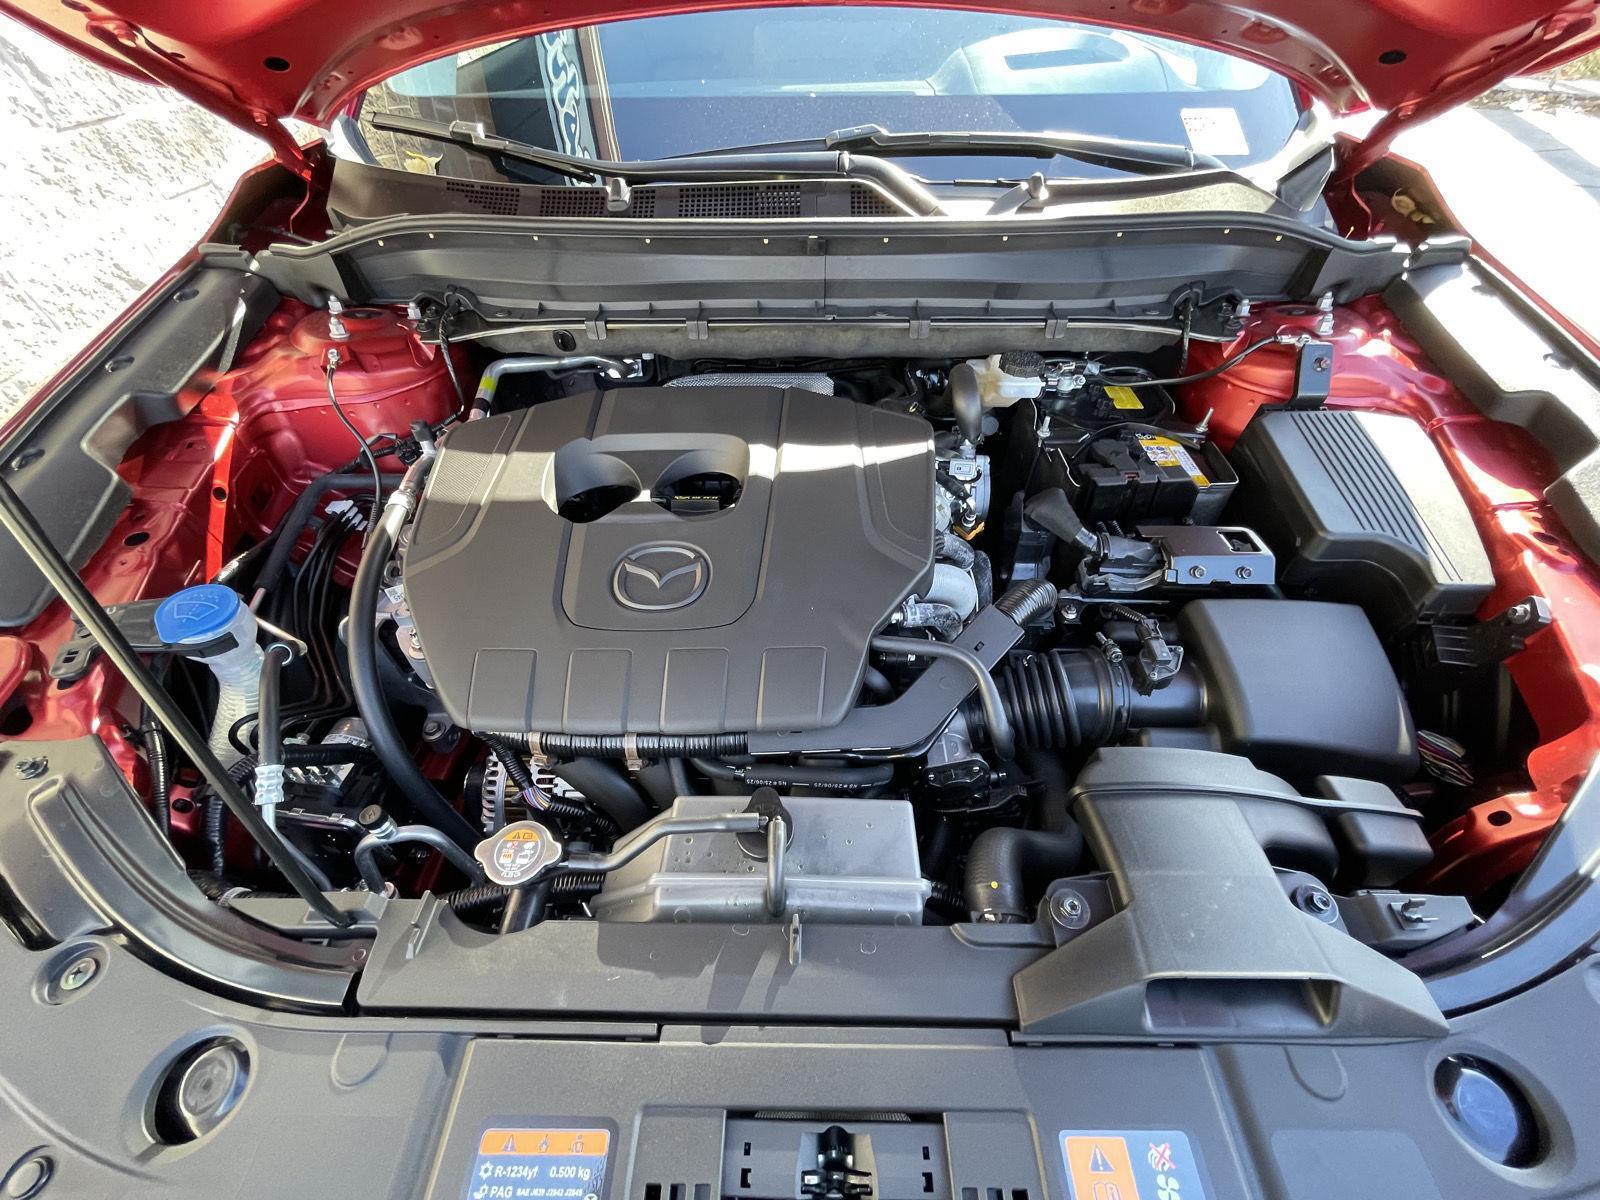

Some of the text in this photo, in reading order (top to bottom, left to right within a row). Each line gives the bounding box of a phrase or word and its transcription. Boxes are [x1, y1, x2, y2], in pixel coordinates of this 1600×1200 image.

[495, 1166, 591, 1181] R-1234yf 0.500 kg
[489, 1185, 513, 1198] PAG
